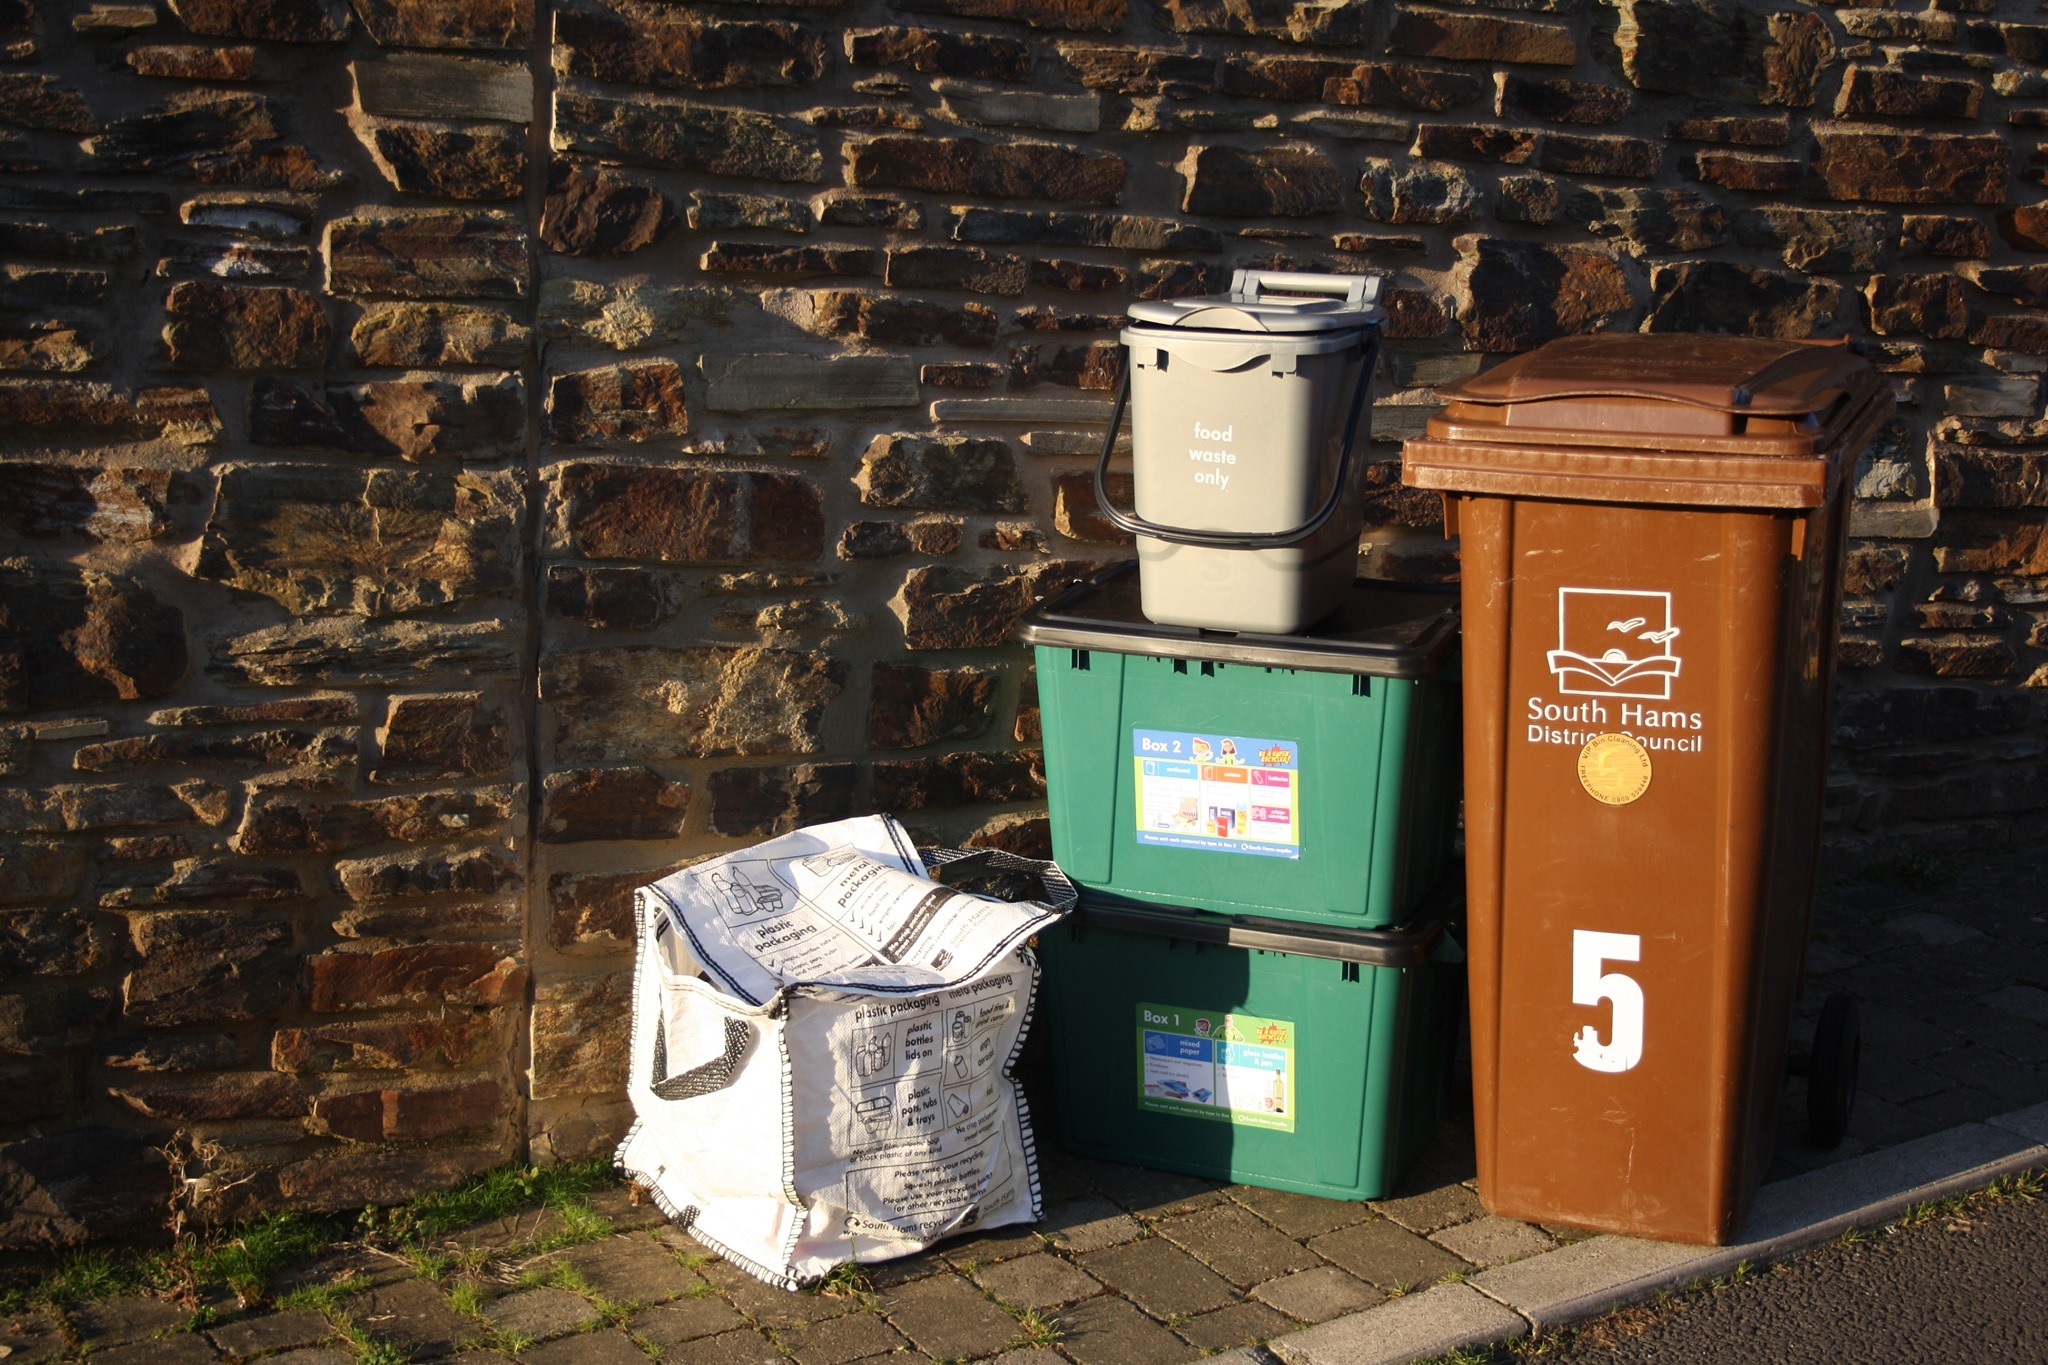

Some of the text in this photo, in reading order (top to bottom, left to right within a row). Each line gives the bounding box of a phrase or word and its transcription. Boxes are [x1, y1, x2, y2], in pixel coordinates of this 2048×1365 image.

[1194, 421, 1232, 442] food
[1188, 448, 1236, 465] waste
[1194, 468, 1229, 490] only
[1528, 697, 1702, 729] South Hams
[1142, 737, 1181, 753] Box 2
[1528, 725, 1702, 752] Distric ouncil
[1582, 735, 1649, 768] VIP Bin Cleaning Ltd
[1580, 765, 1609, 801] FREEPHONE
[840, 860, 871, 887] metal
[755, 925, 818, 953] packaging
[757, 920, 794, 939] plastic
[971, 974, 1013, 995] packaging
[855, 995, 940, 1023] plastic packaging
[1572, 929, 1644, 1073] 5
[1143, 1010, 1180, 1026] Box 1
[907, 1020, 933, 1036] plastic
[905, 1034, 934, 1047] bottles
[1180, 1040, 1200, 1048] mixed
[905, 1049, 933, 1060] lids on
[1180, 1048, 1200, 1056] paper
[1243, 1048, 1285, 1060] glass bottles
[1253, 1057, 1274, 1067] & jars
[908, 1086, 931, 1103] plastic
[901, 1098, 938, 1118] pots, tubs
[907, 1114, 936, 1126] & trays
[956, 1126, 965, 1135] No
[860, 1152, 879, 1161] black
[880, 1151, 903, 1161] plastic
[913, 1150, 927, 1158] any
[928, 1145, 942, 1155] kind
[895, 1150, 985, 1178] Please rinse your recycling
[934, 1176, 958, 1189] plastic
[883, 1196, 909, 1205] Please
[925, 1189, 945, 1200] your
[945, 1181, 977, 1196] recycling
[893, 1205, 906, 1213] for
[907, 1201, 927, 1211] other
[929, 1193, 968, 1208] recyclable
